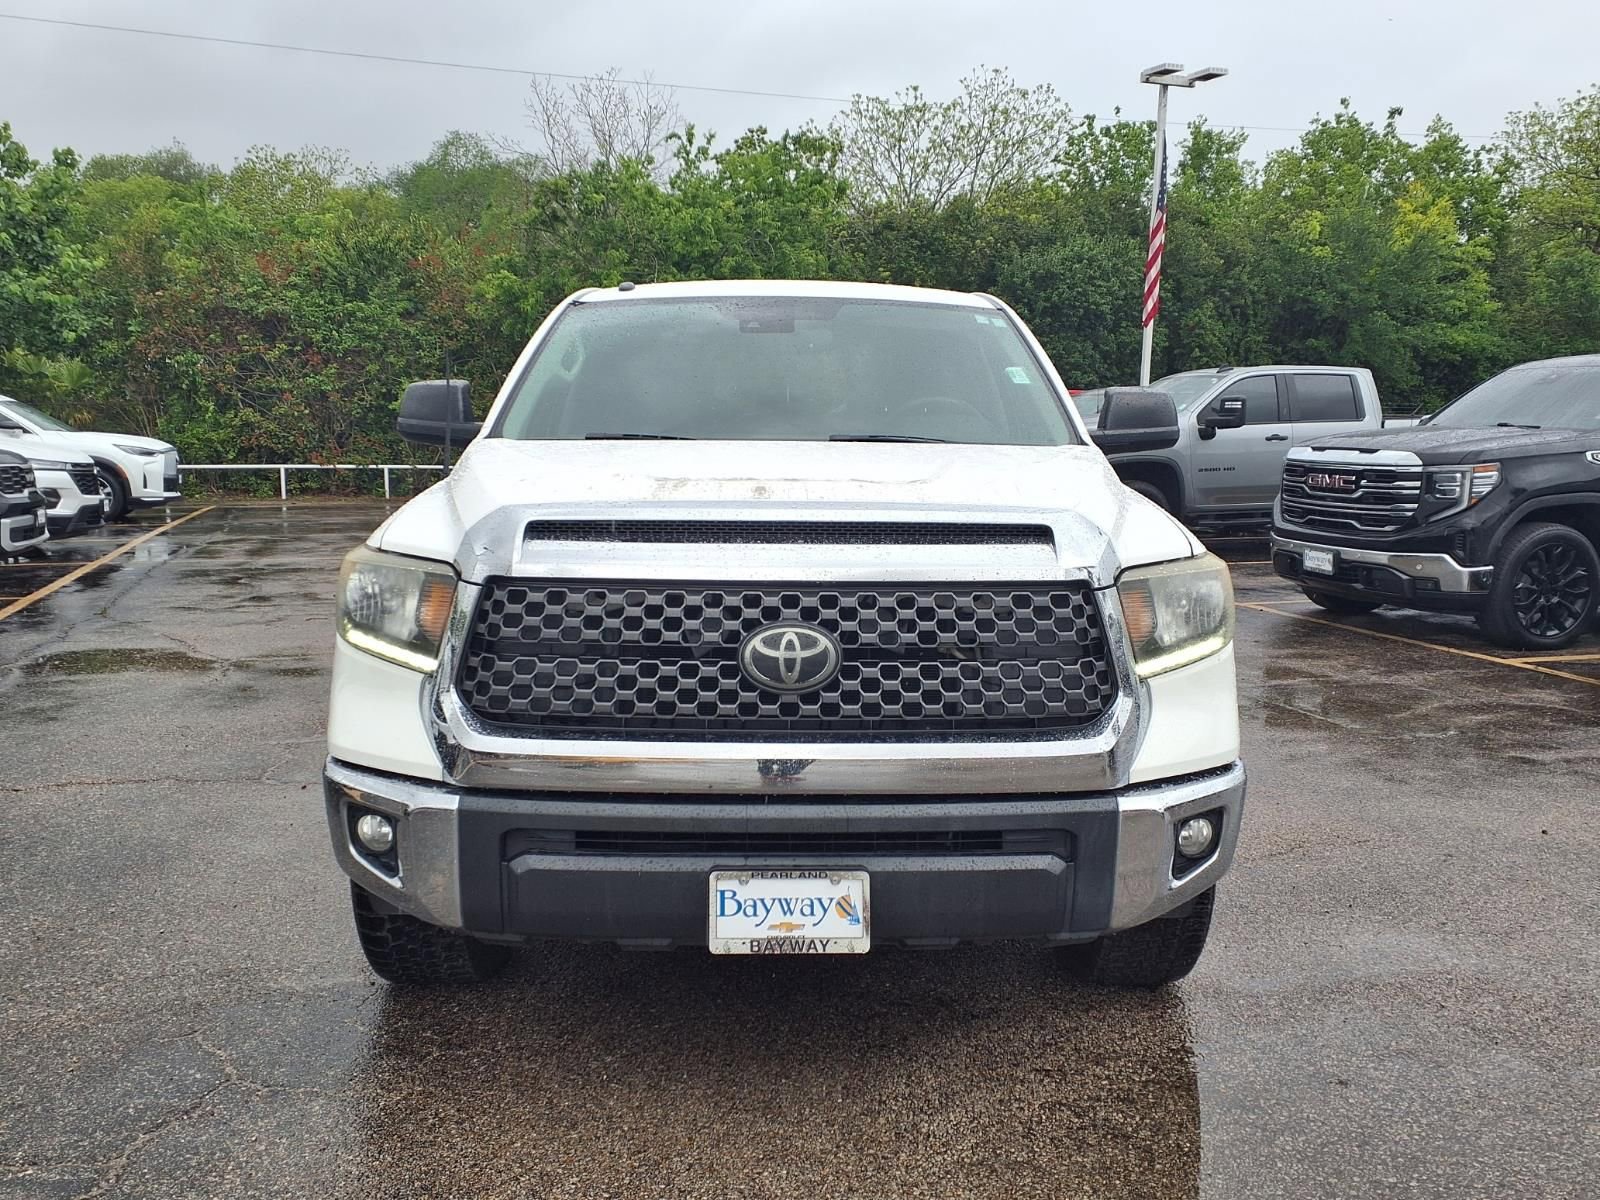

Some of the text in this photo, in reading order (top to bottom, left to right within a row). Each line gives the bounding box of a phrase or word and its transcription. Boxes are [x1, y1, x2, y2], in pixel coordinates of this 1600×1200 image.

[1307, 473, 1356, 489] GMC
[751, 871, 828, 880] PEARLAND
[717, 889, 835, 927] Bayway
[750, 939, 830, 953] BAYWAY
